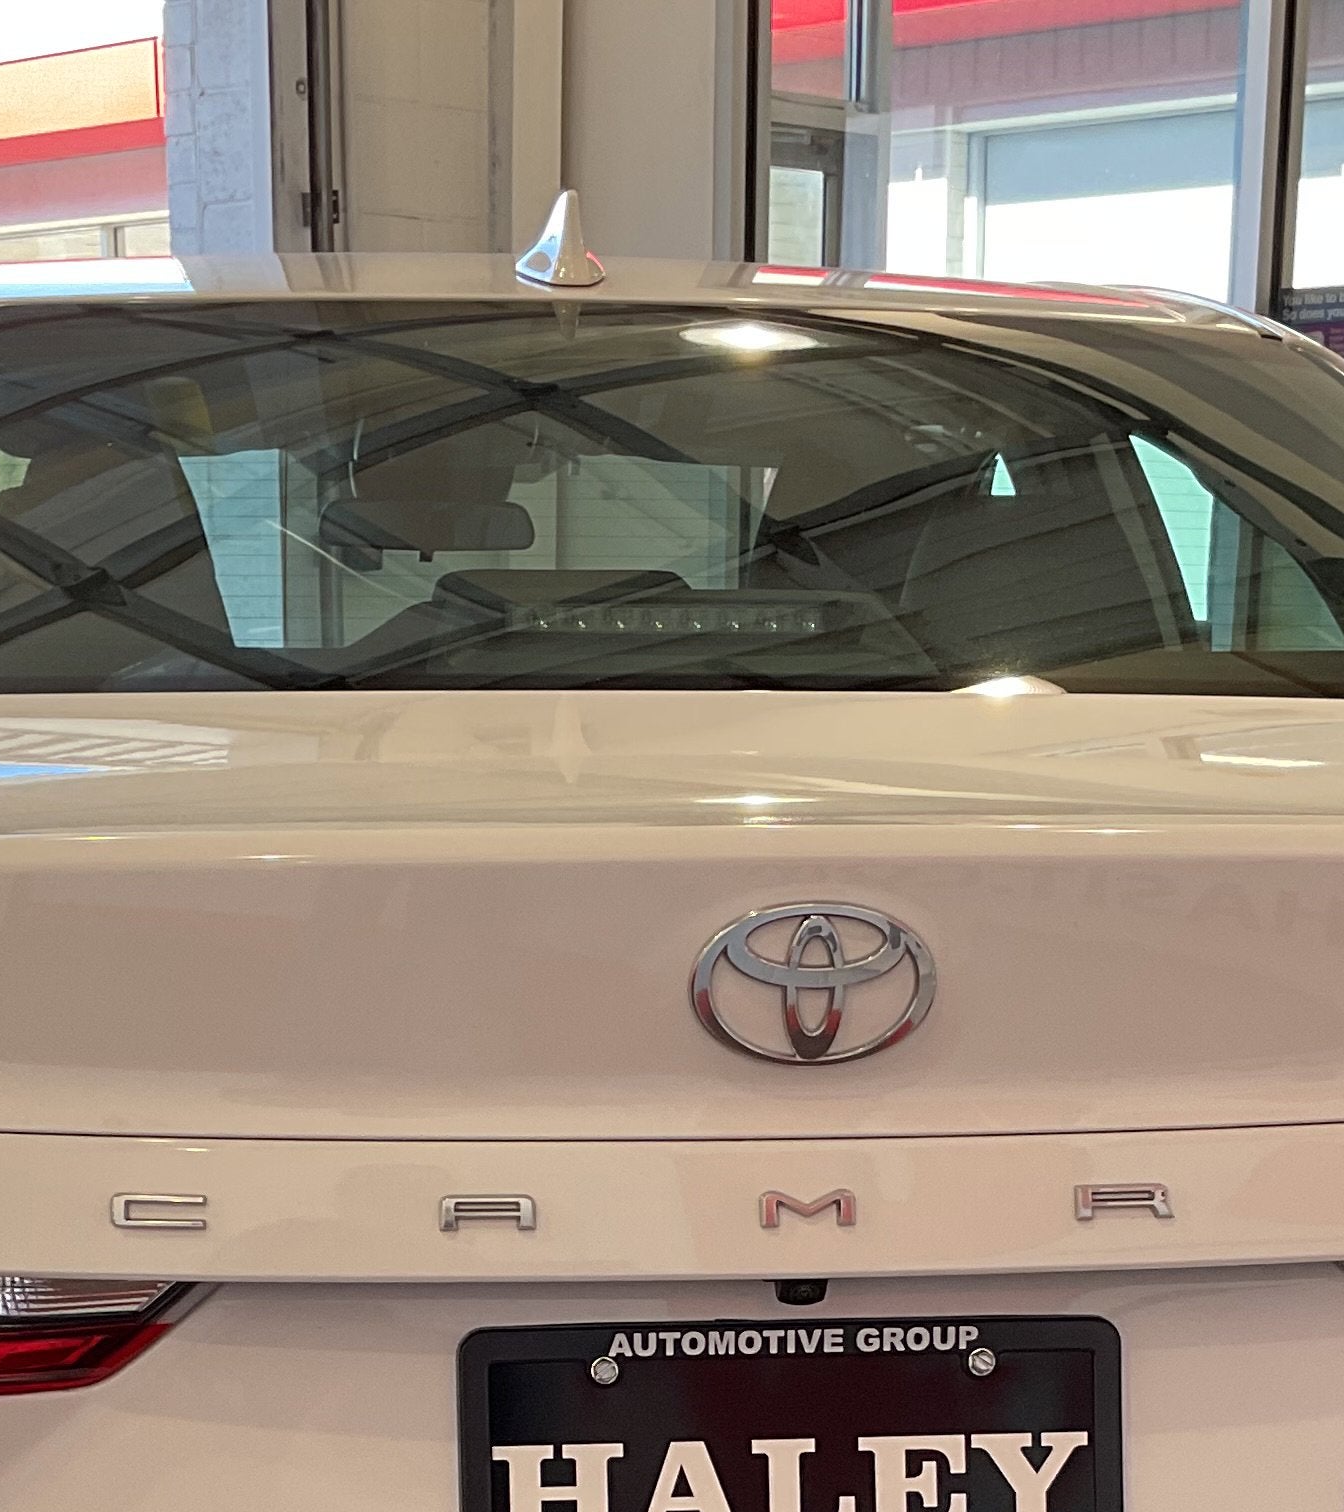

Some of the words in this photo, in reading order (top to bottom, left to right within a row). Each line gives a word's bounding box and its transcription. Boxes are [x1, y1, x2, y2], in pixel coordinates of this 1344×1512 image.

[1304, 291, 1324, 303] like
[1325, 290, 1338, 303] to
[1282, 308, 1298, 321] So
[1299, 306, 1325, 320] does
[608, 1329, 845, 1359] AUTOMOTIVE
[855, 1325, 980, 1353] GROUP
